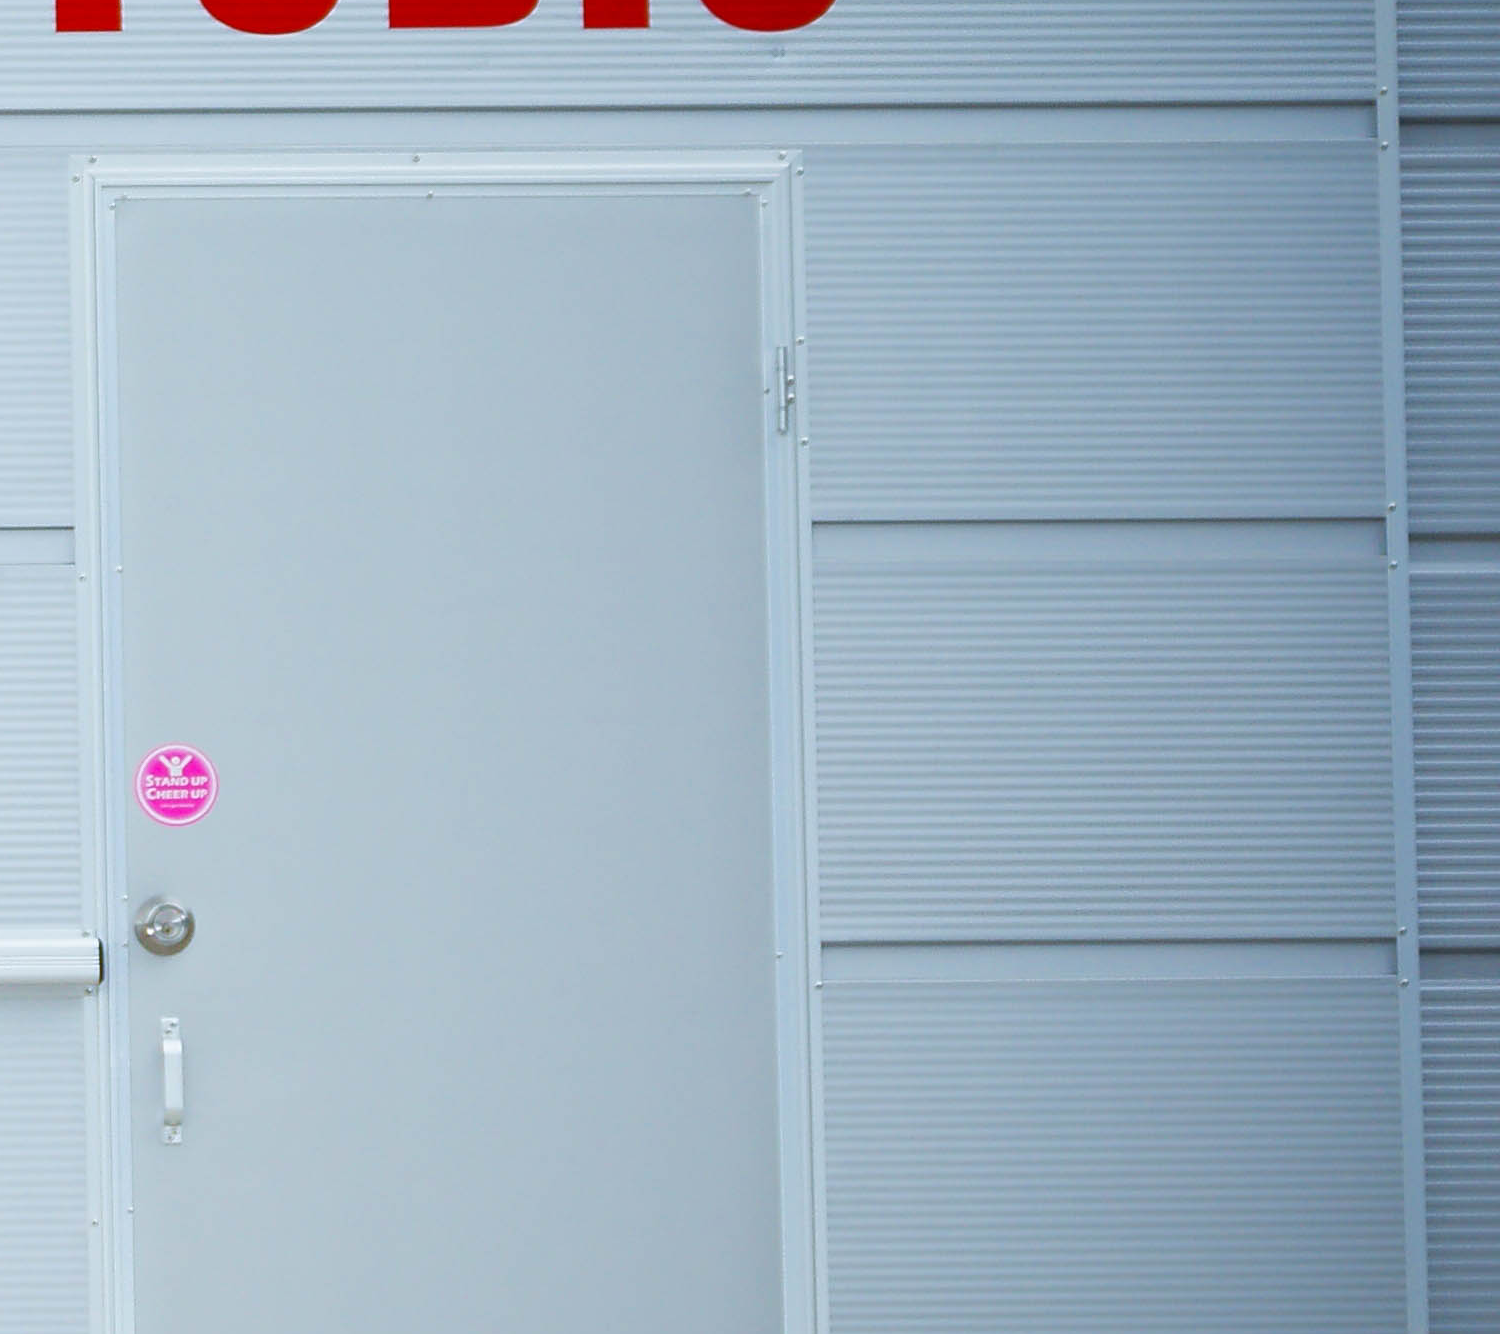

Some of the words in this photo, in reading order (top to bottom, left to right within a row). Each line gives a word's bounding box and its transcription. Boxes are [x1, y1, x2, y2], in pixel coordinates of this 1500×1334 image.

[146, 774, 189, 787] STAND
[190, 775, 208, 787] UP
[146, 787, 189, 800] CHEER
[190, 788, 208, 800] UP
